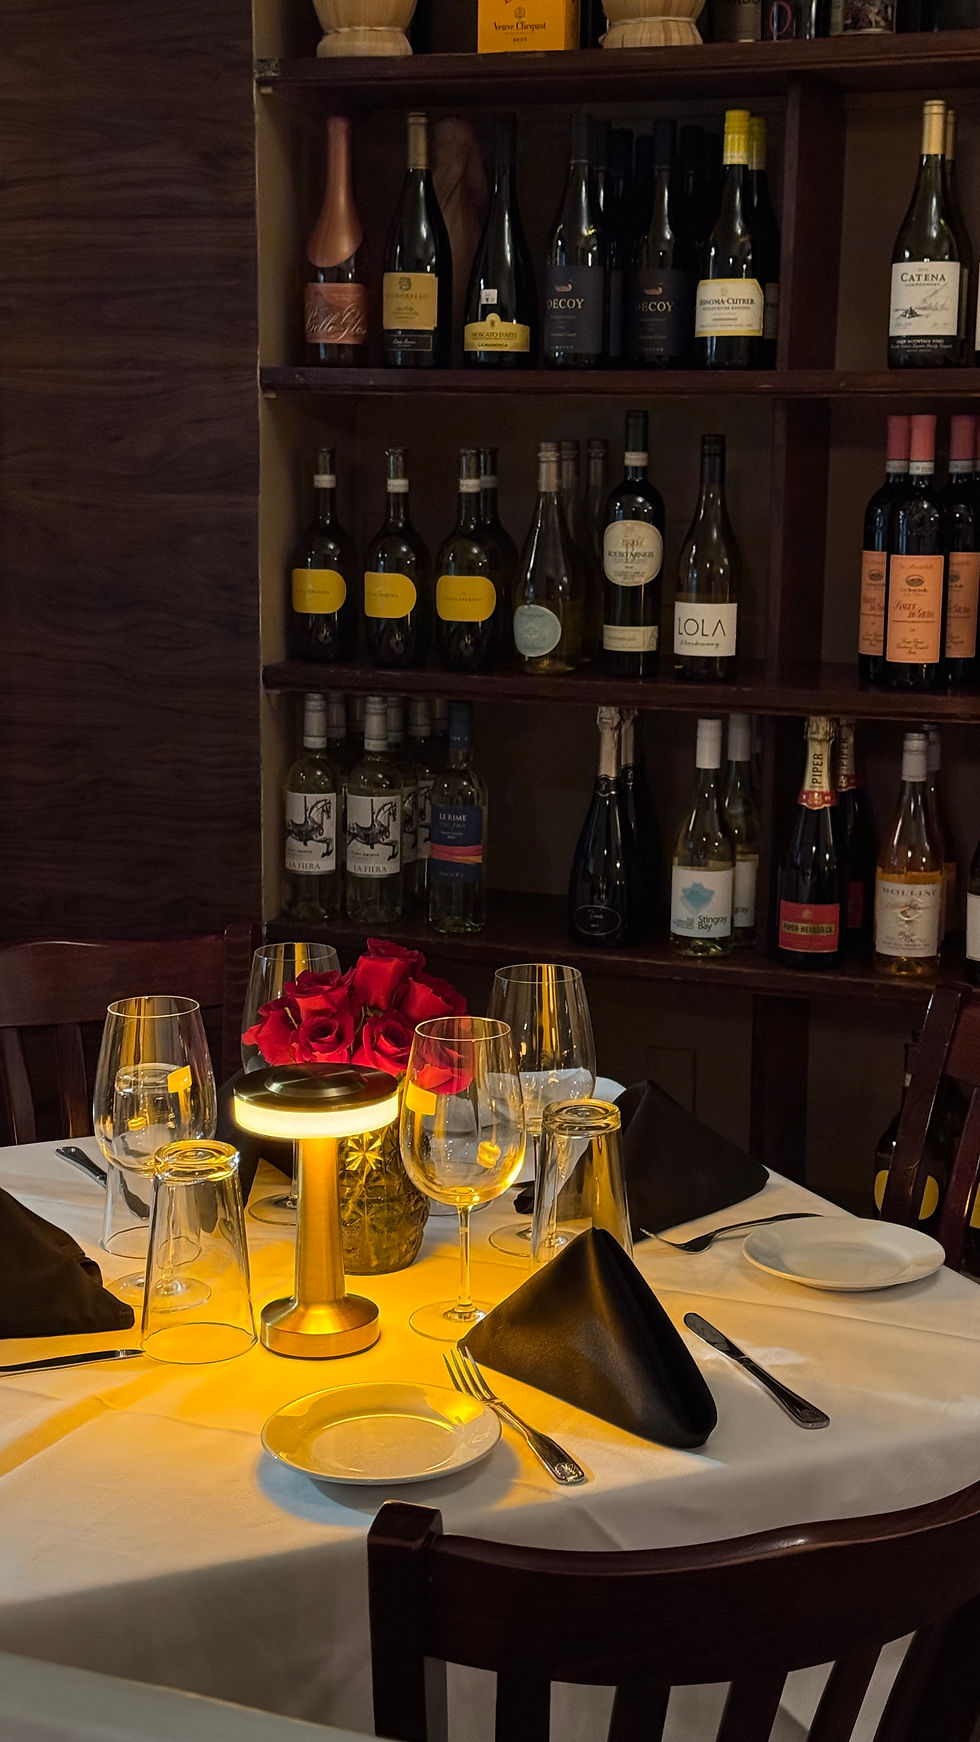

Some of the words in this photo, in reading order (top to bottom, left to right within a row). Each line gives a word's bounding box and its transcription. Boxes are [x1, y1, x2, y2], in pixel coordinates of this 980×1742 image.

[900, 272, 946, 282] CATENA
[547, 298, 585, 309] DECOY
[678, 617, 726, 637] LOLA
[812, 753, 824, 785] PIPER
[698, 914, 728, 925] Stingray
[697, 921, 713, 932] Bay
